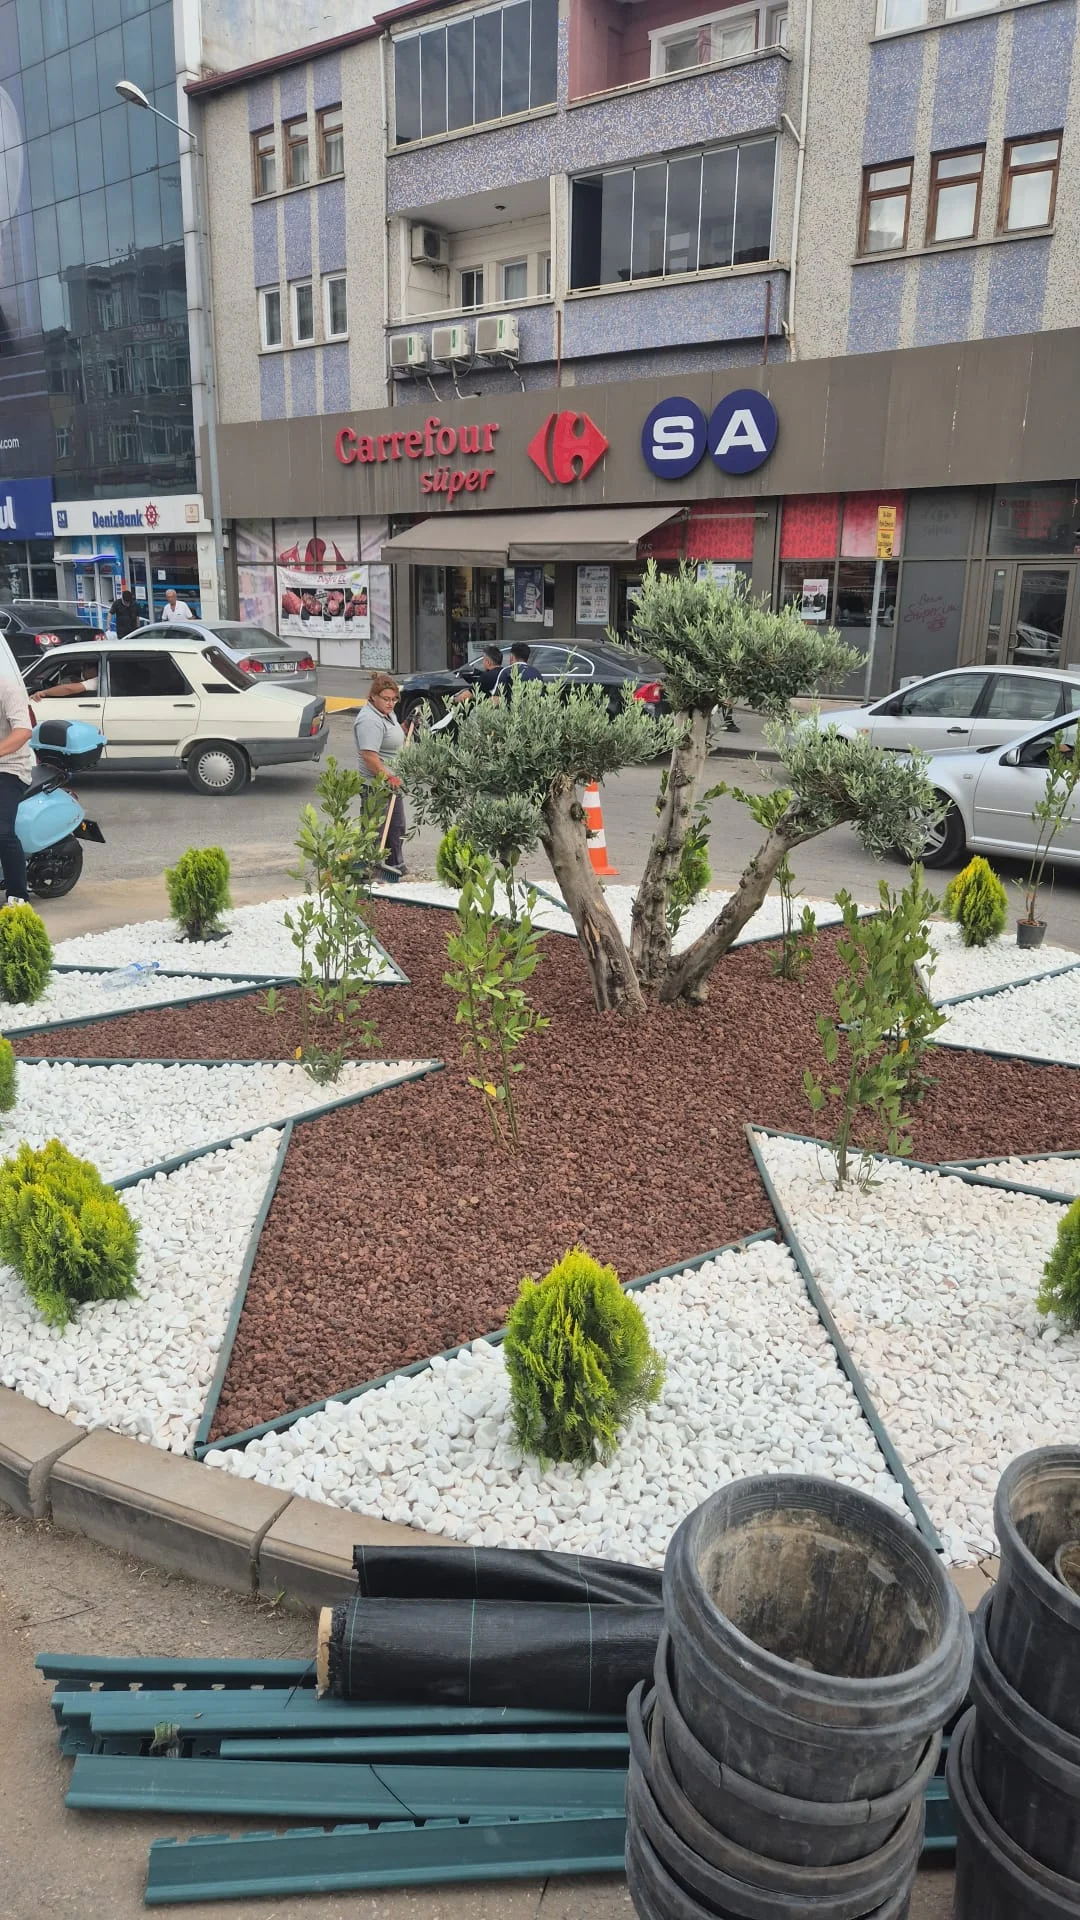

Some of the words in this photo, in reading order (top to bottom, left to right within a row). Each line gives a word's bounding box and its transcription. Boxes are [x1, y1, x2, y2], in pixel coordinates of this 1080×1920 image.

[335, 416, 500, 464] Carrefour
[652, 409, 767, 460] SA
[420, 467, 496, 503] süper
[92, 509, 144, 528] DenizBank
